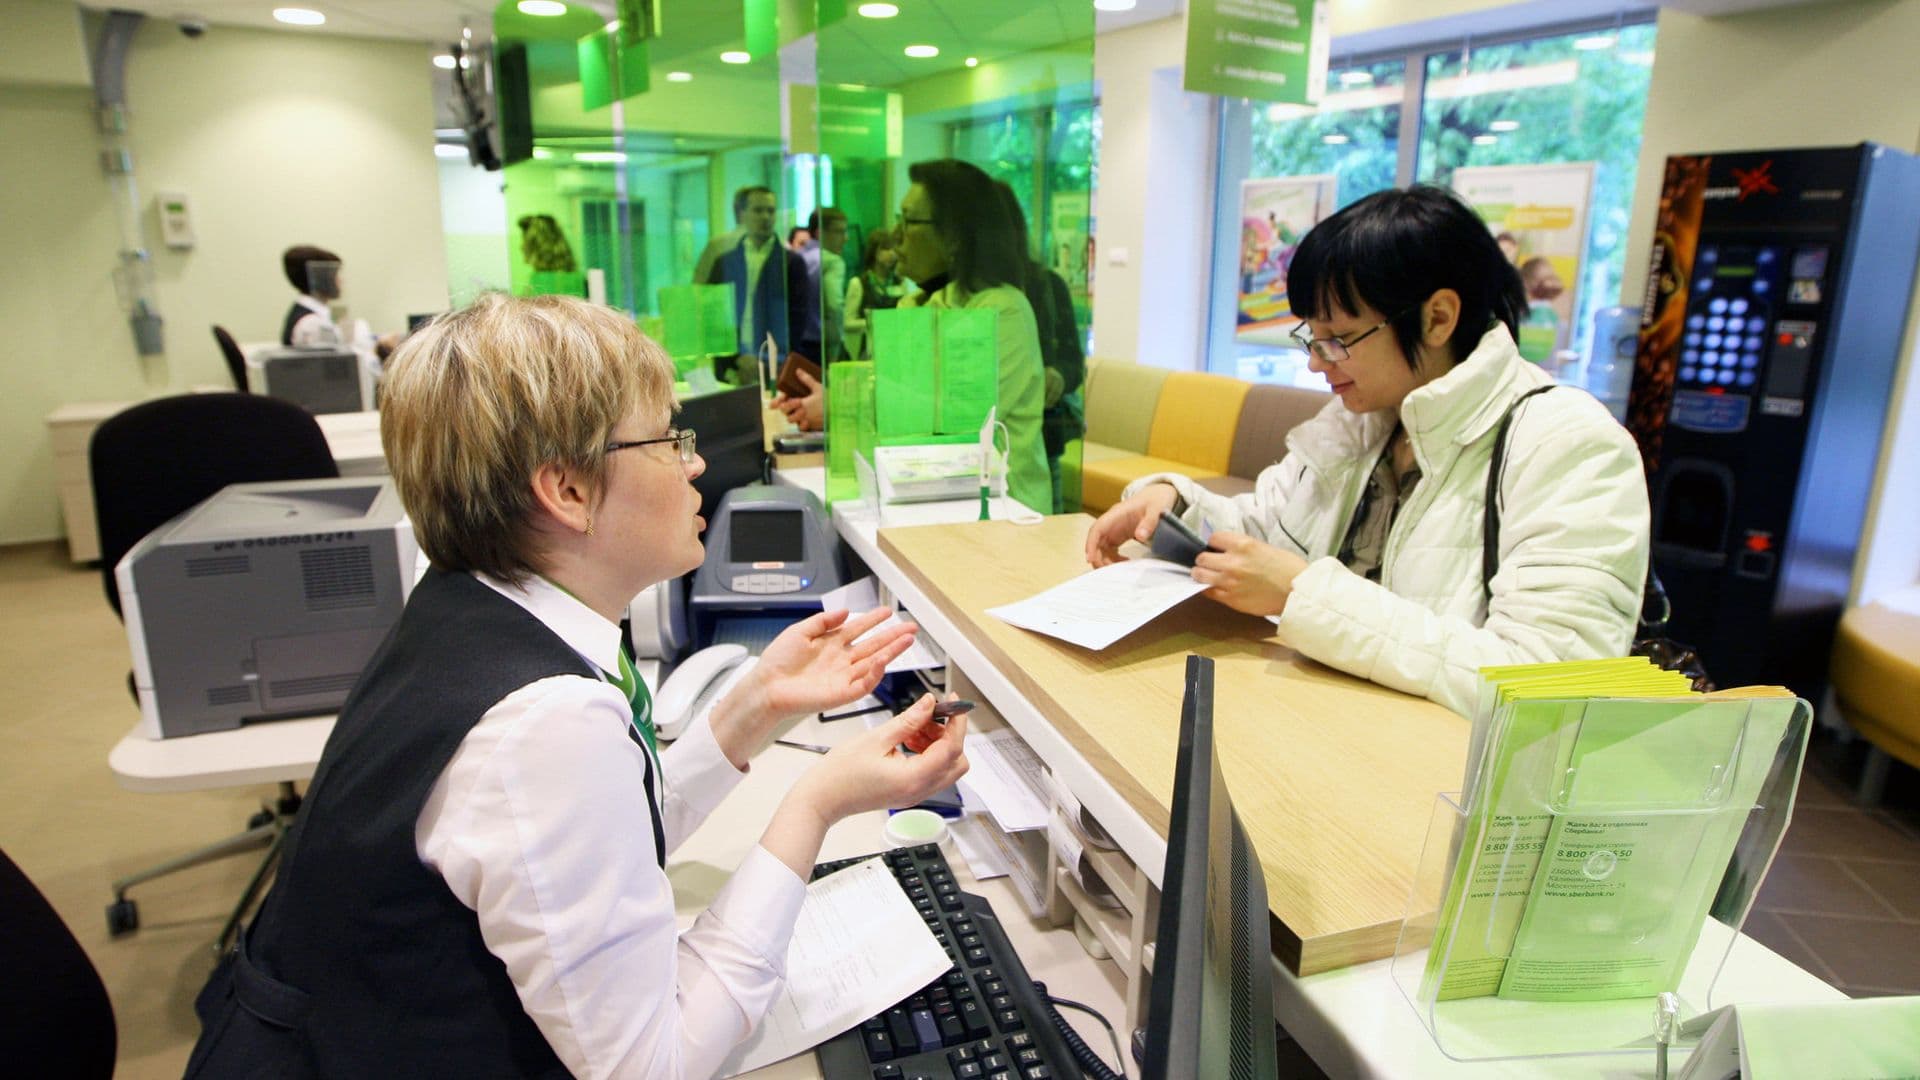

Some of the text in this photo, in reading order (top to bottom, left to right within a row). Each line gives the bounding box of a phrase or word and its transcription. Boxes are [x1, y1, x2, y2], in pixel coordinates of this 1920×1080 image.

[1484, 843, 1492, 852] 8
[1557, 849, 1565, 857] 8
[1566, 850, 1587, 858] 800
[1619, 849, 1633, 857] 50
[1544, 890, 1616, 898] www.sberbank.ru
